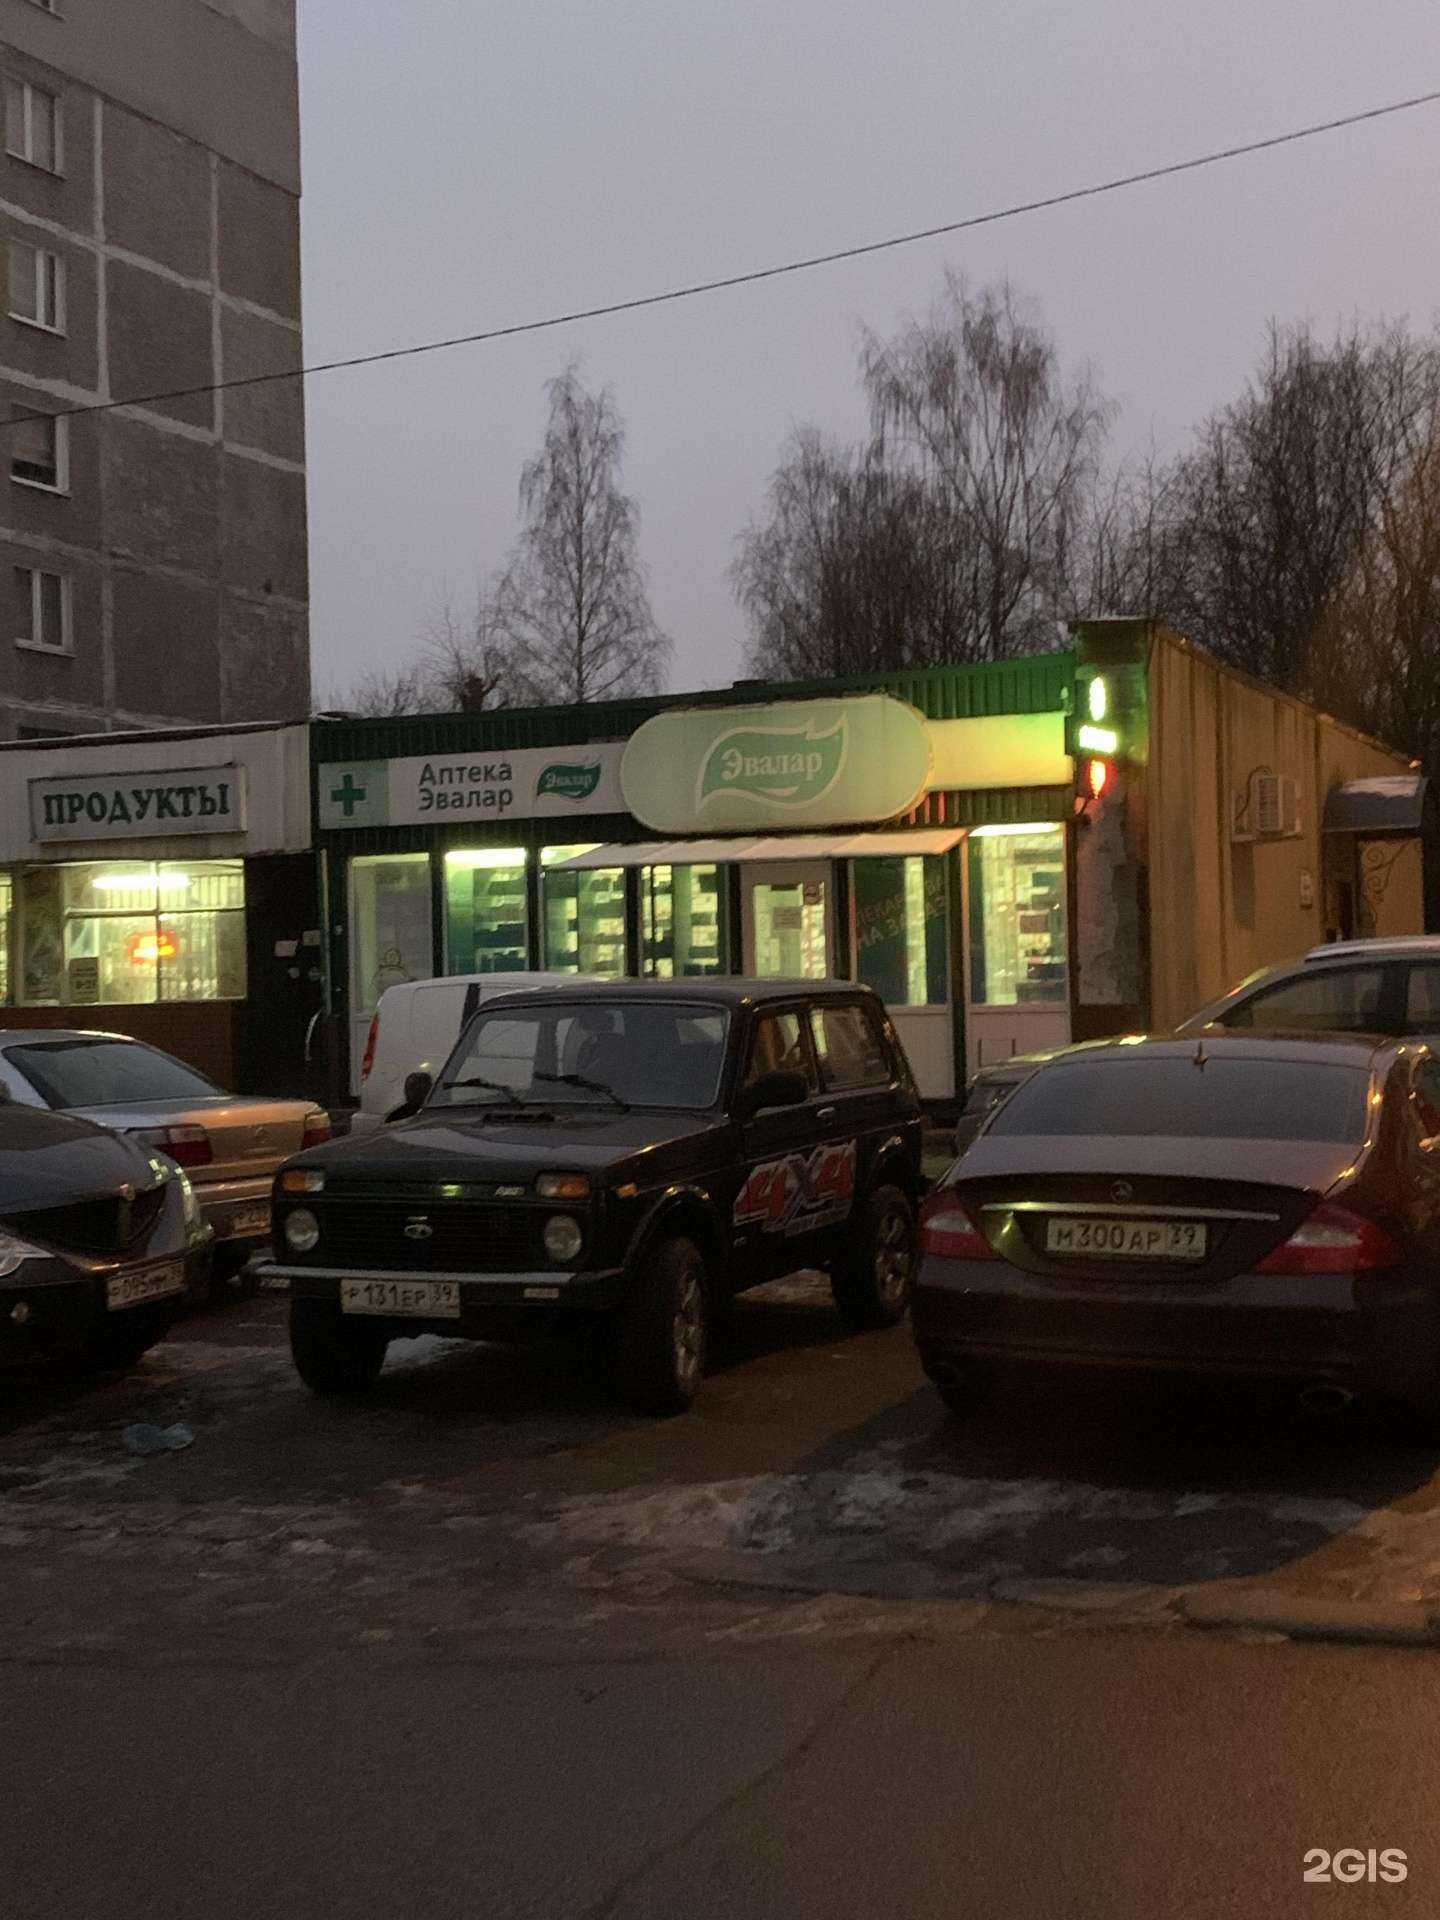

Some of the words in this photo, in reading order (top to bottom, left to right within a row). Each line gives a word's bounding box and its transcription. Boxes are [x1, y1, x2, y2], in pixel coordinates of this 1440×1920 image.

[418, 762, 513, 786] Аптека
[721, 748, 823, 781] Эвалар
[42, 783, 230, 825] ПРОДУКТЫ
[418, 787, 514, 812] Эвалар
